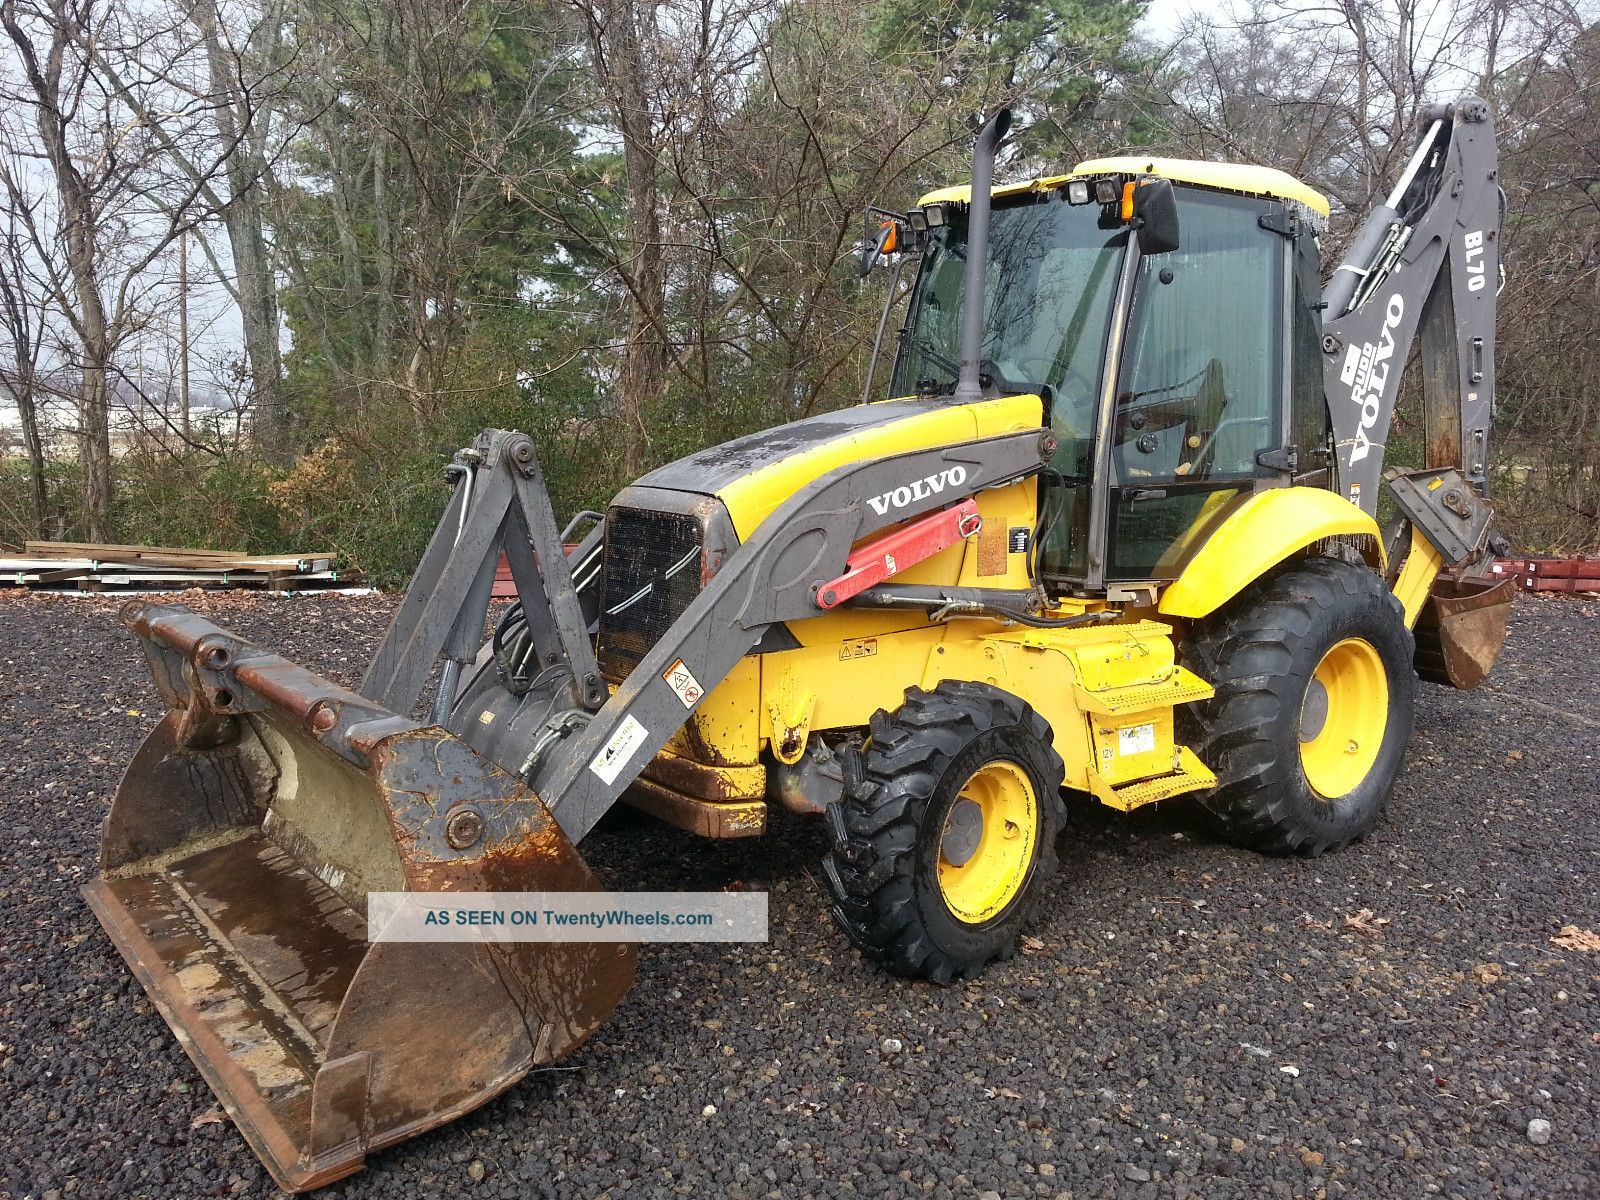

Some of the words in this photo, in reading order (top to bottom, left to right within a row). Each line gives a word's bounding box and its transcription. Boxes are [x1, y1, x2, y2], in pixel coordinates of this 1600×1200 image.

[1465, 231, 1485, 291] BL70
[1349, 293, 1404, 467] VOLVO
[1351, 341, 1373, 404] RUDD
[866, 465, 967, 515] VOLVO
